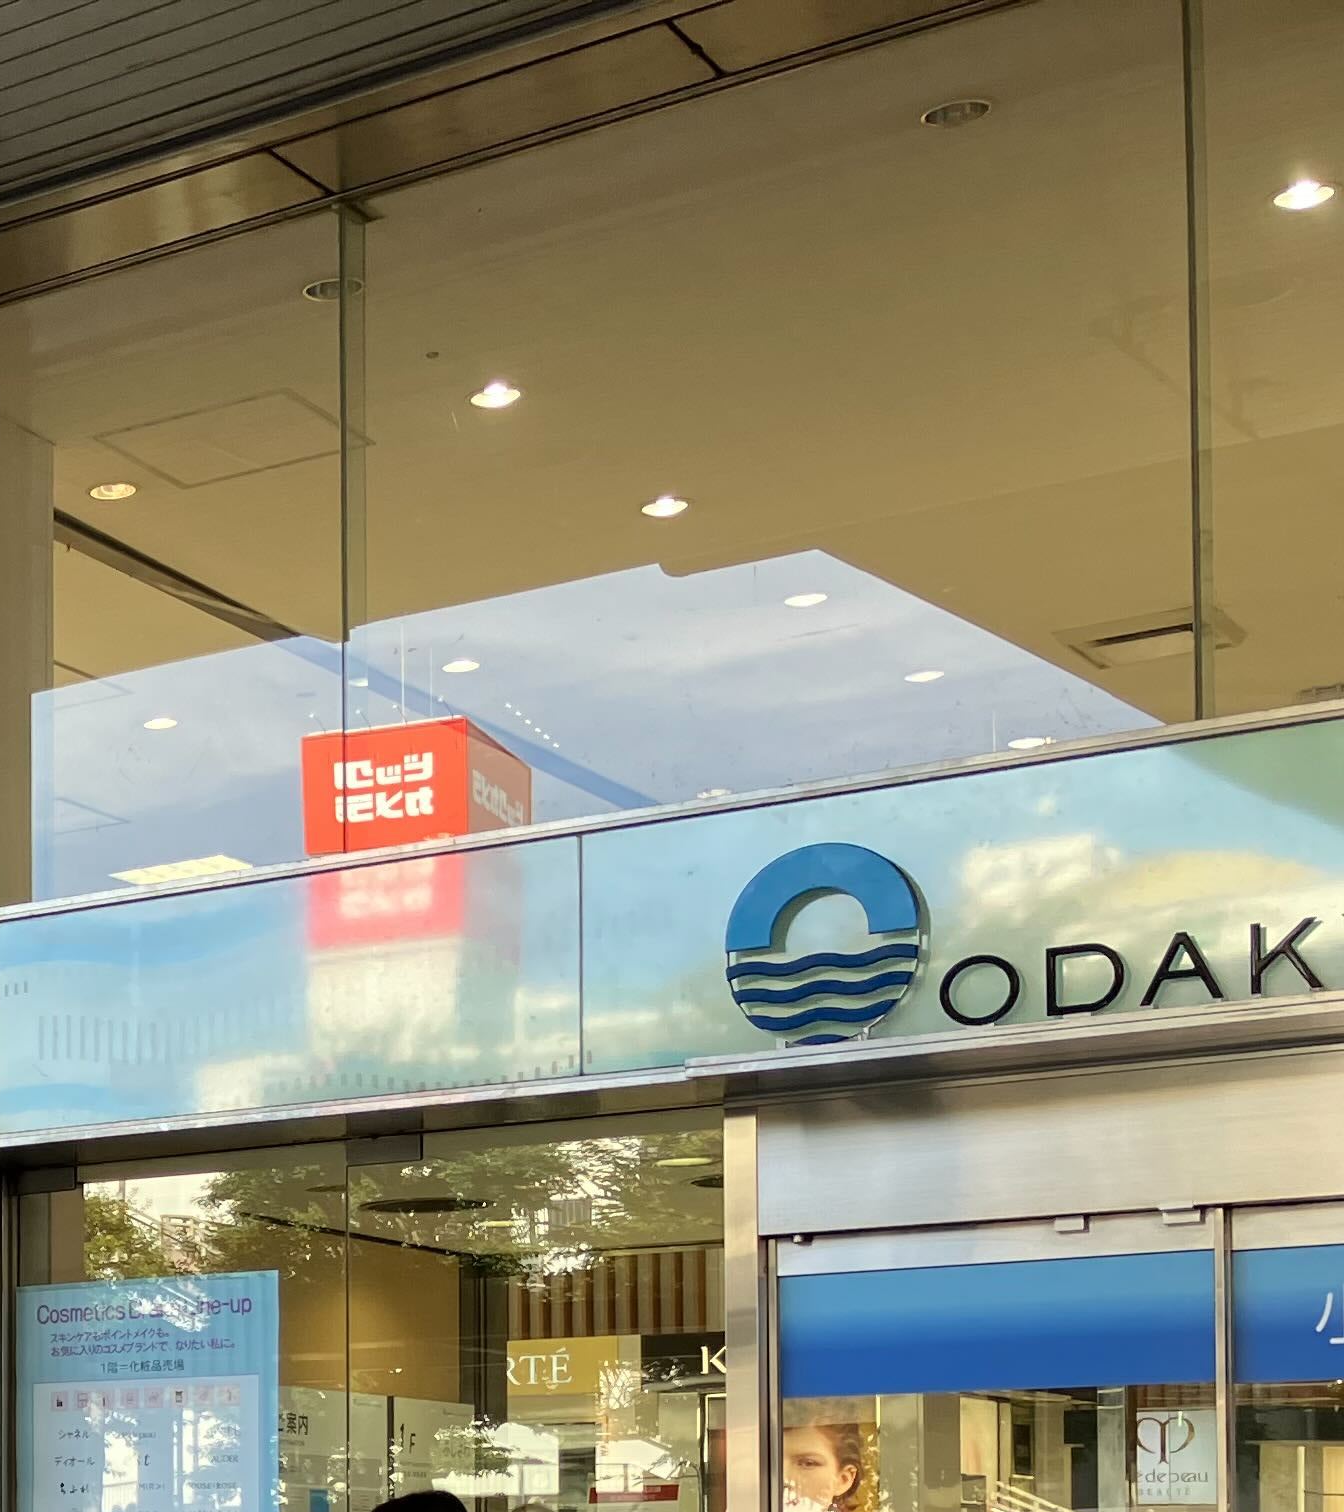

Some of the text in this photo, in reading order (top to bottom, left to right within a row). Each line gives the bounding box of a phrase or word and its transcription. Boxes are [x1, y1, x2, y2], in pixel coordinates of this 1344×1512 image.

[939, 914, 1344, 1026] ODAK
[37, 1303, 126, 1324] Cosmetics
[58, 1429, 90, 1440] シャネル
